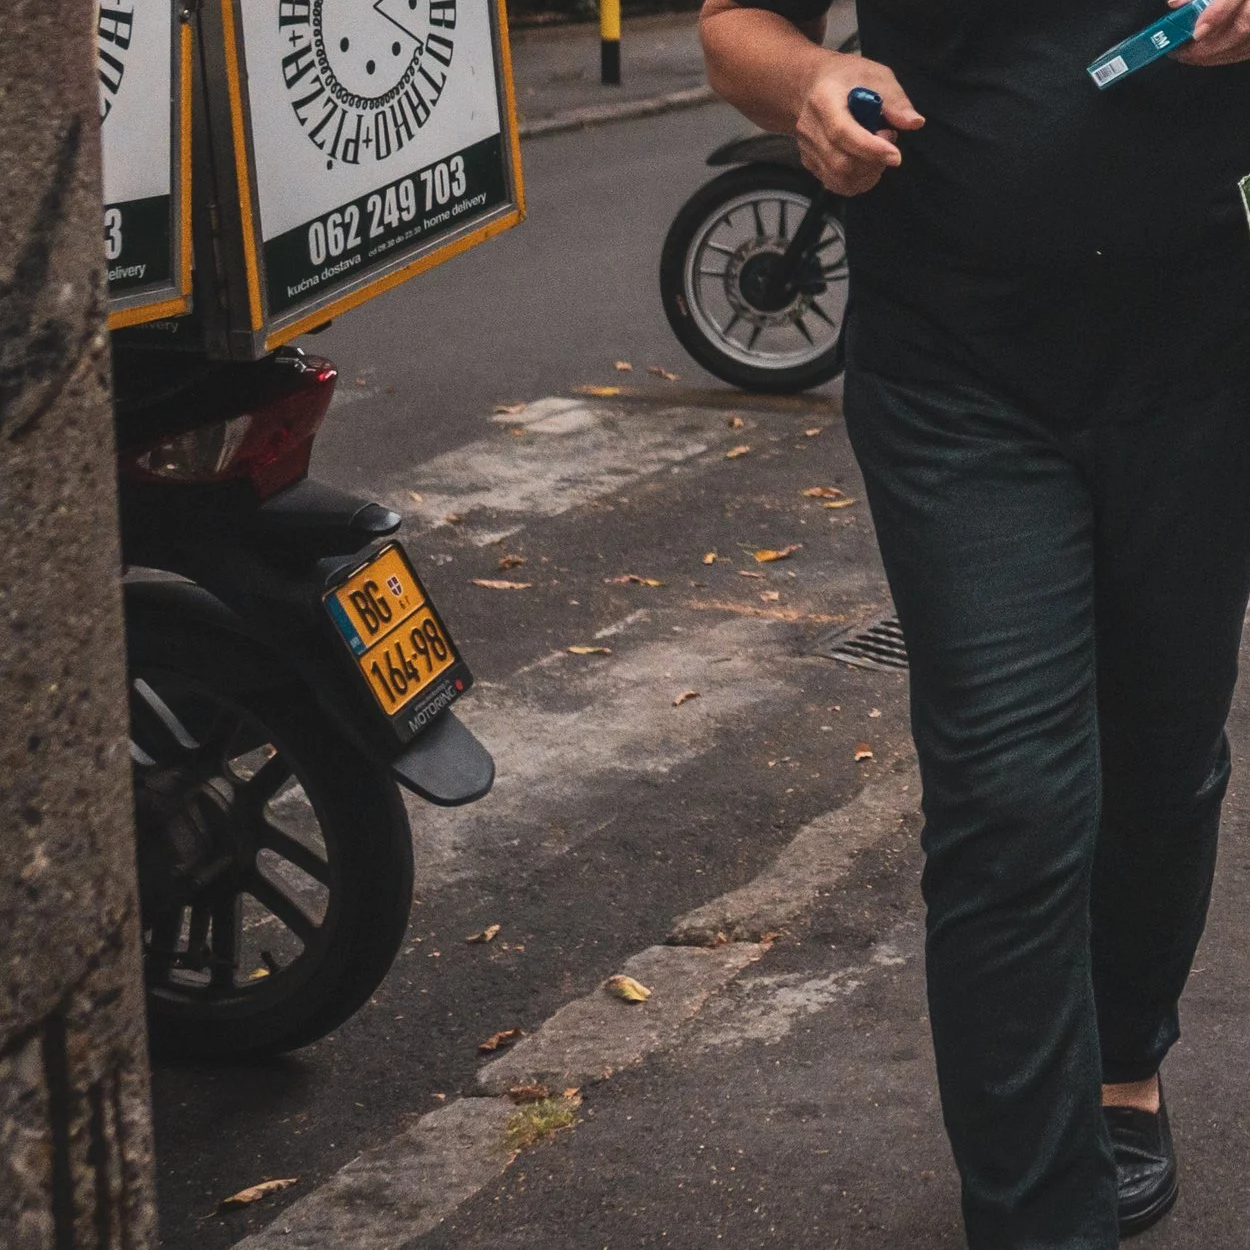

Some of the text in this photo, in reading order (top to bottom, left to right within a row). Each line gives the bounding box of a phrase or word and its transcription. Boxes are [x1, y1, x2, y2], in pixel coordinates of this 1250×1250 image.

[308, 155, 467, 266] 062 249 703
[321, 254, 362, 280] dostava
[423, 211, 450, 230] home
[451, 193, 487, 216] delivery
[107, 264, 146, 281] elivery
[349, 580, 393, 636] BG
[370, 618, 448, 704] 164-98
[408, 685, 457, 733] MOTORING
